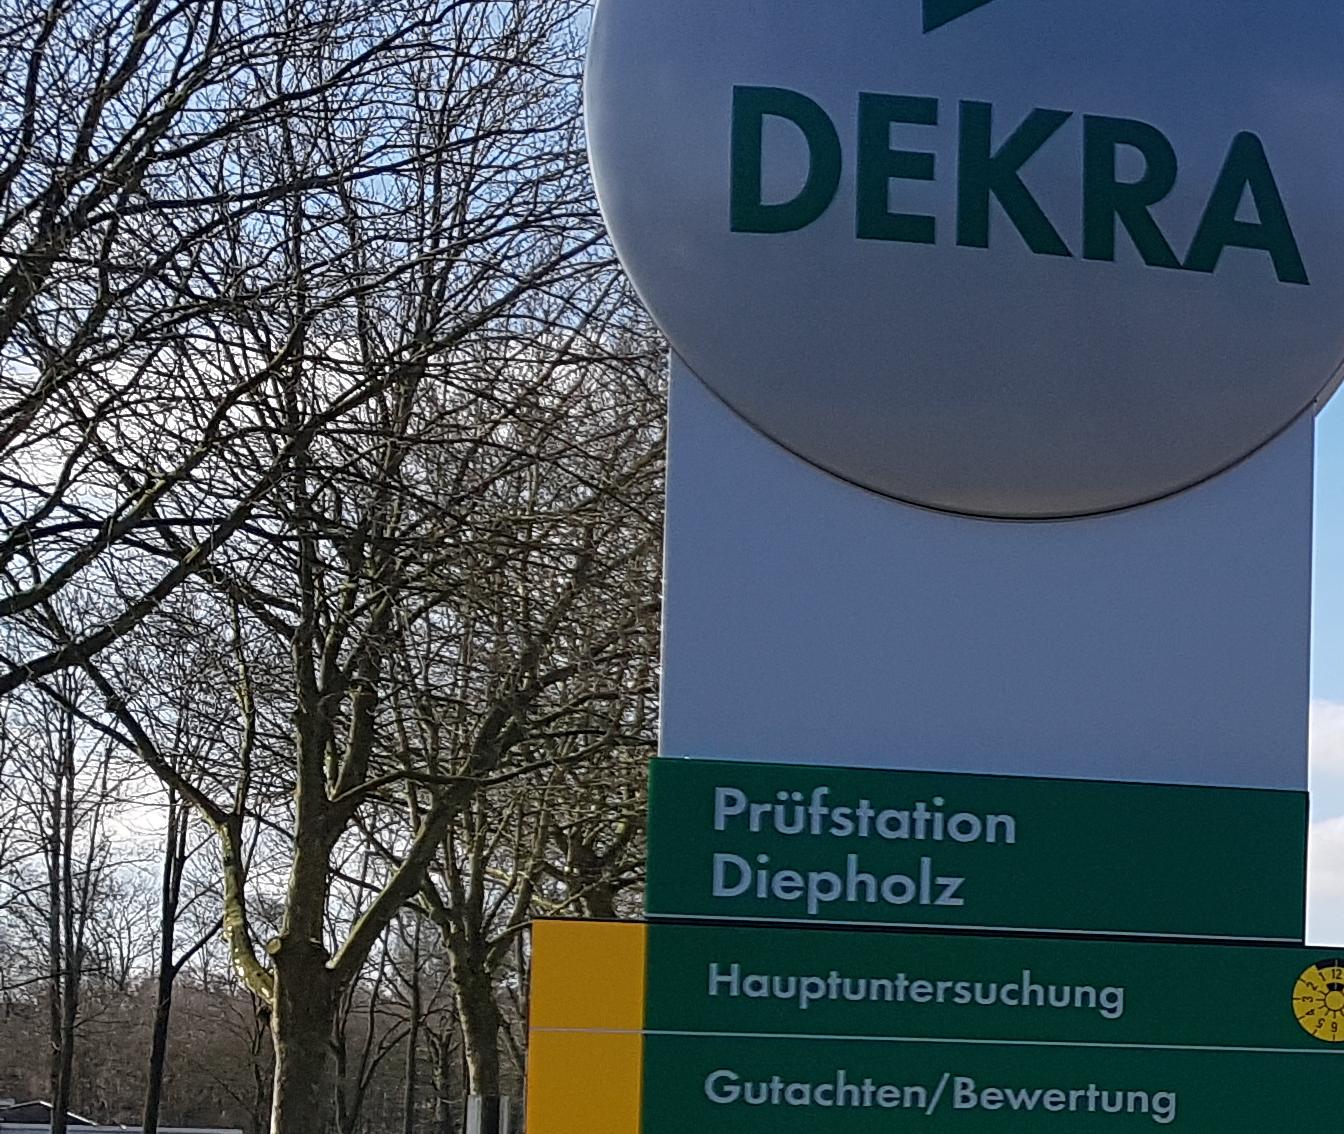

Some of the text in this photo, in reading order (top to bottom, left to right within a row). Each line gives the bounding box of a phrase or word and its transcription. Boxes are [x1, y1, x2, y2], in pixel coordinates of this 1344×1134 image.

[730, 85, 1309, 285] DEKRA
[714, 786, 1015, 844] Prüfstation
[712, 853, 965, 915] Diepholz
[709, 962, 1124, 1019] Hauptuntersuchung
[705, 1069, 1176, 1124] Gutachten/Bewertung
